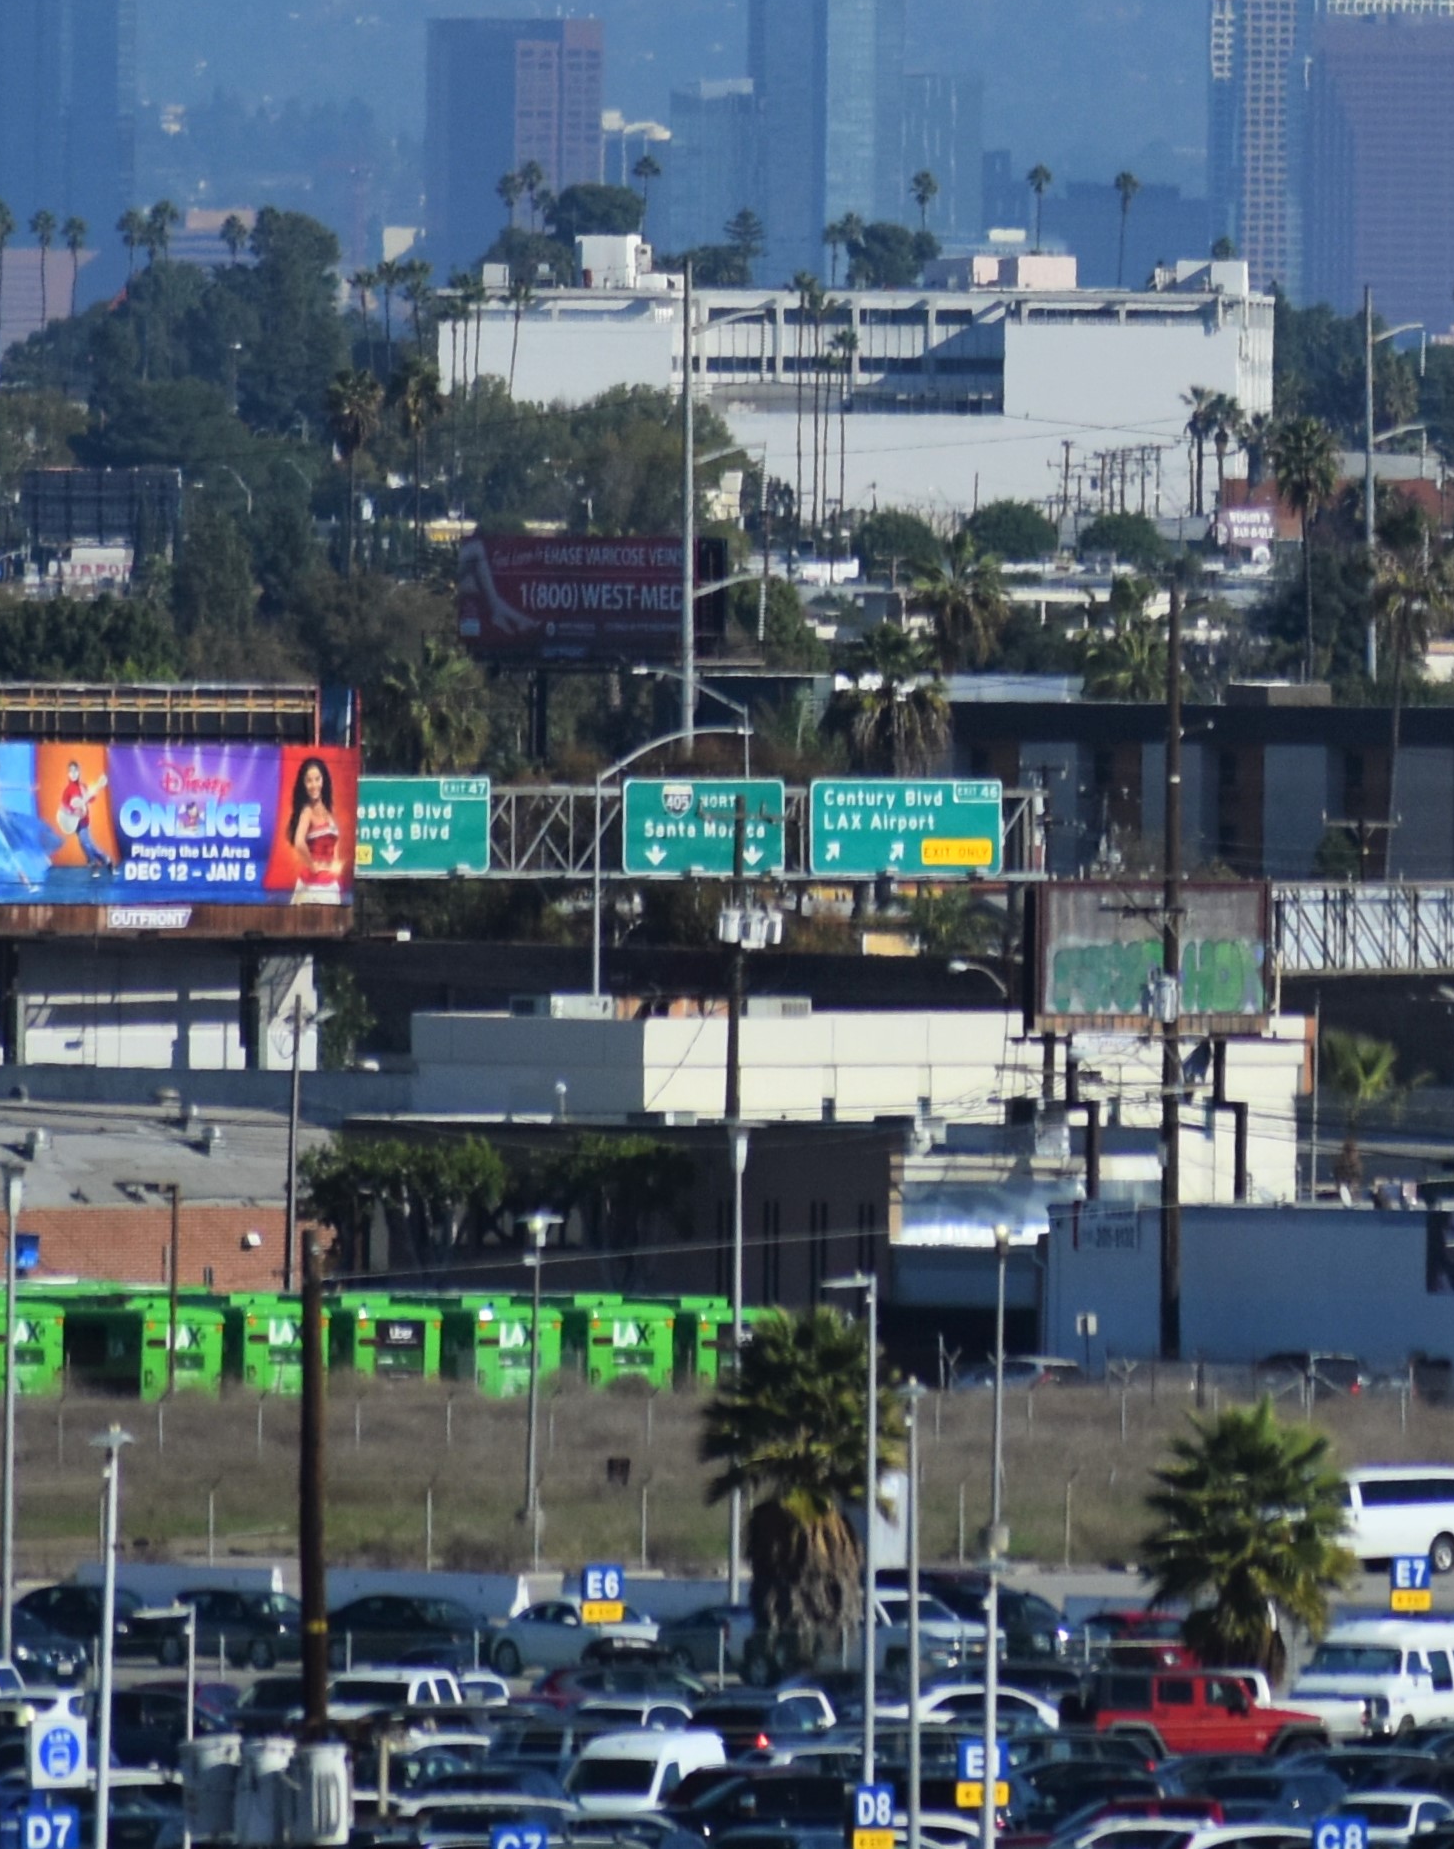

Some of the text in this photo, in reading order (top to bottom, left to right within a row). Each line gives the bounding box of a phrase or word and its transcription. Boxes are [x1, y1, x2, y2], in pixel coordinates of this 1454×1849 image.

[585, 543, 644, 567] VARICOSE
[519, 581, 579, 611] 1(800)
[157, 757, 234, 801] Disney
[444, 783, 486, 794] EXIT 47
[666, 795, 736, 811] 405 NORT
[823, 788, 943, 810] Century Blvd
[957, 787, 999, 798] EXIT 46
[119, 796, 261, 838] ON ICE
[357, 802, 453, 819] ester Blvd
[644, 819, 765, 838] Santa Monca
[823, 812, 934, 833] LAX Airport
[355, 823, 450, 844] nega Blvd
[131, 844, 250, 860] Playing the LA Area
[923, 847, 989, 858] EXIT ONLY
[124, 862, 162, 881] DEC
[167, 863, 189, 881] 12
[205, 863, 240, 881] JAN
[244, 863, 257, 881] 5
[110, 912, 187, 926] OUTFRONT
[13, 1318, 40, 1345] AX
[389, 1325, 413, 1340] Uber
[612, 1320, 650, 1349] LAX
[1395, 1558, 1426, 1588] E7
[586, 1569, 620, 1599] E6
[857, 1791, 891, 1826] D8
[27, 1814, 72, 1849] D7
